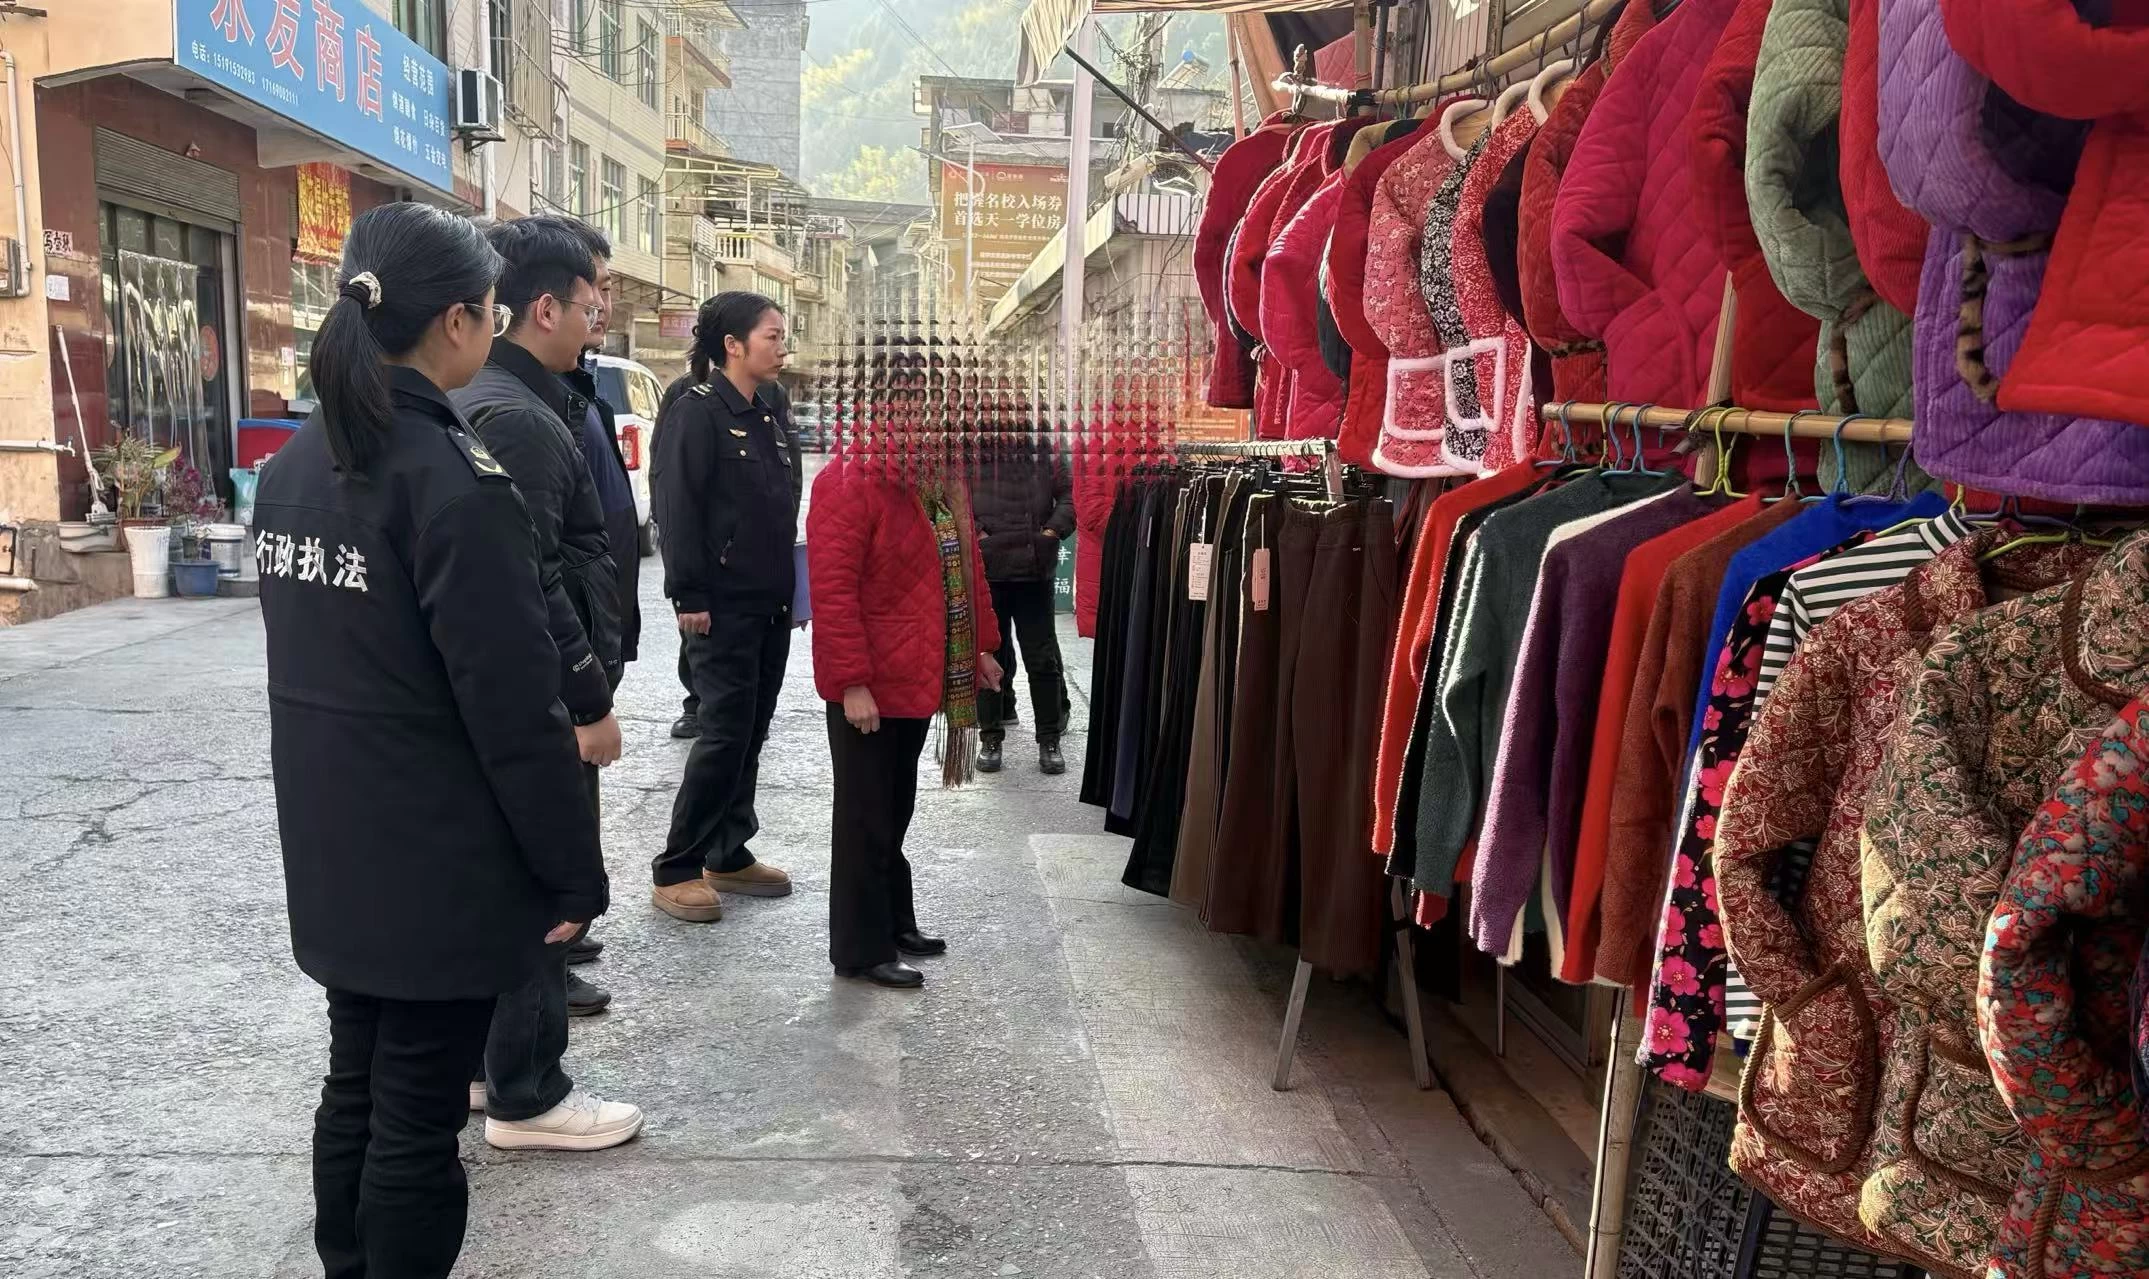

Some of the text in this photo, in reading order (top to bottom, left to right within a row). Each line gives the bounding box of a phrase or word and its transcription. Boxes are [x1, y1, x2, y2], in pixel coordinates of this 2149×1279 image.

[402, 54, 434, 97] 经营范围
[953, 210, 1063, 230] 首选天一学位房
[256, 529, 368, 593] 行政执法
[1053, 545, 1073, 595] 幸福
